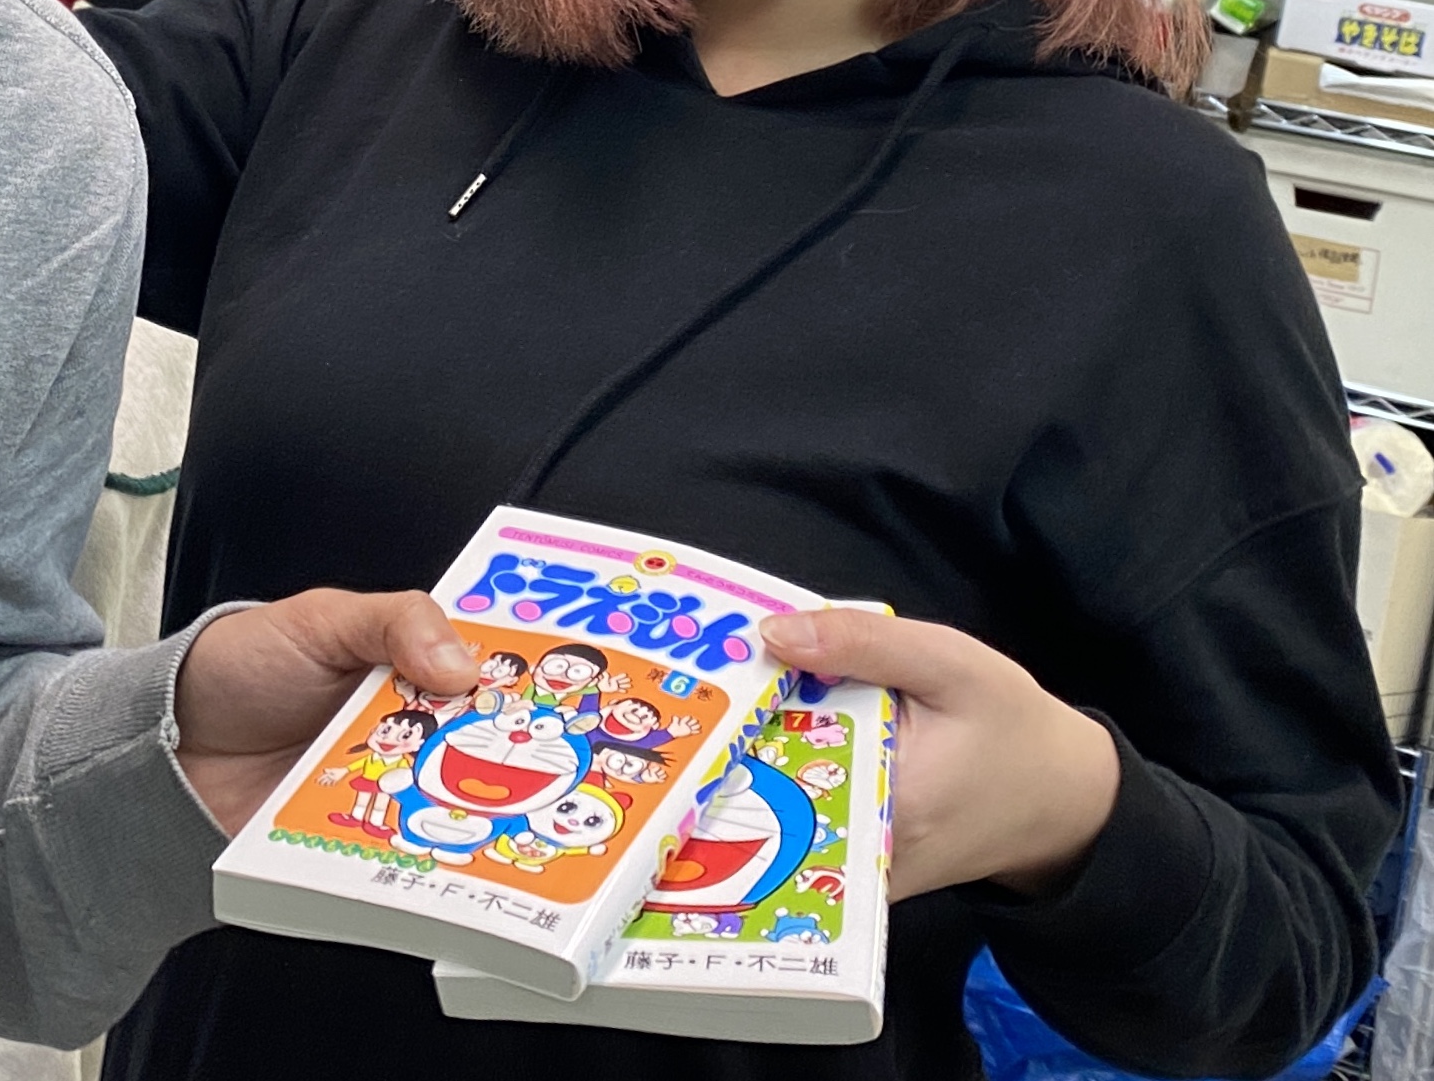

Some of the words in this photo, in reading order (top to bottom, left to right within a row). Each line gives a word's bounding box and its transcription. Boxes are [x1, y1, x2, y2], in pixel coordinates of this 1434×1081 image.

[1341, 19, 1420, 56] やきそば
[579, 543, 624, 559] COMICS
[455, 552, 753, 672] ドラえもん
